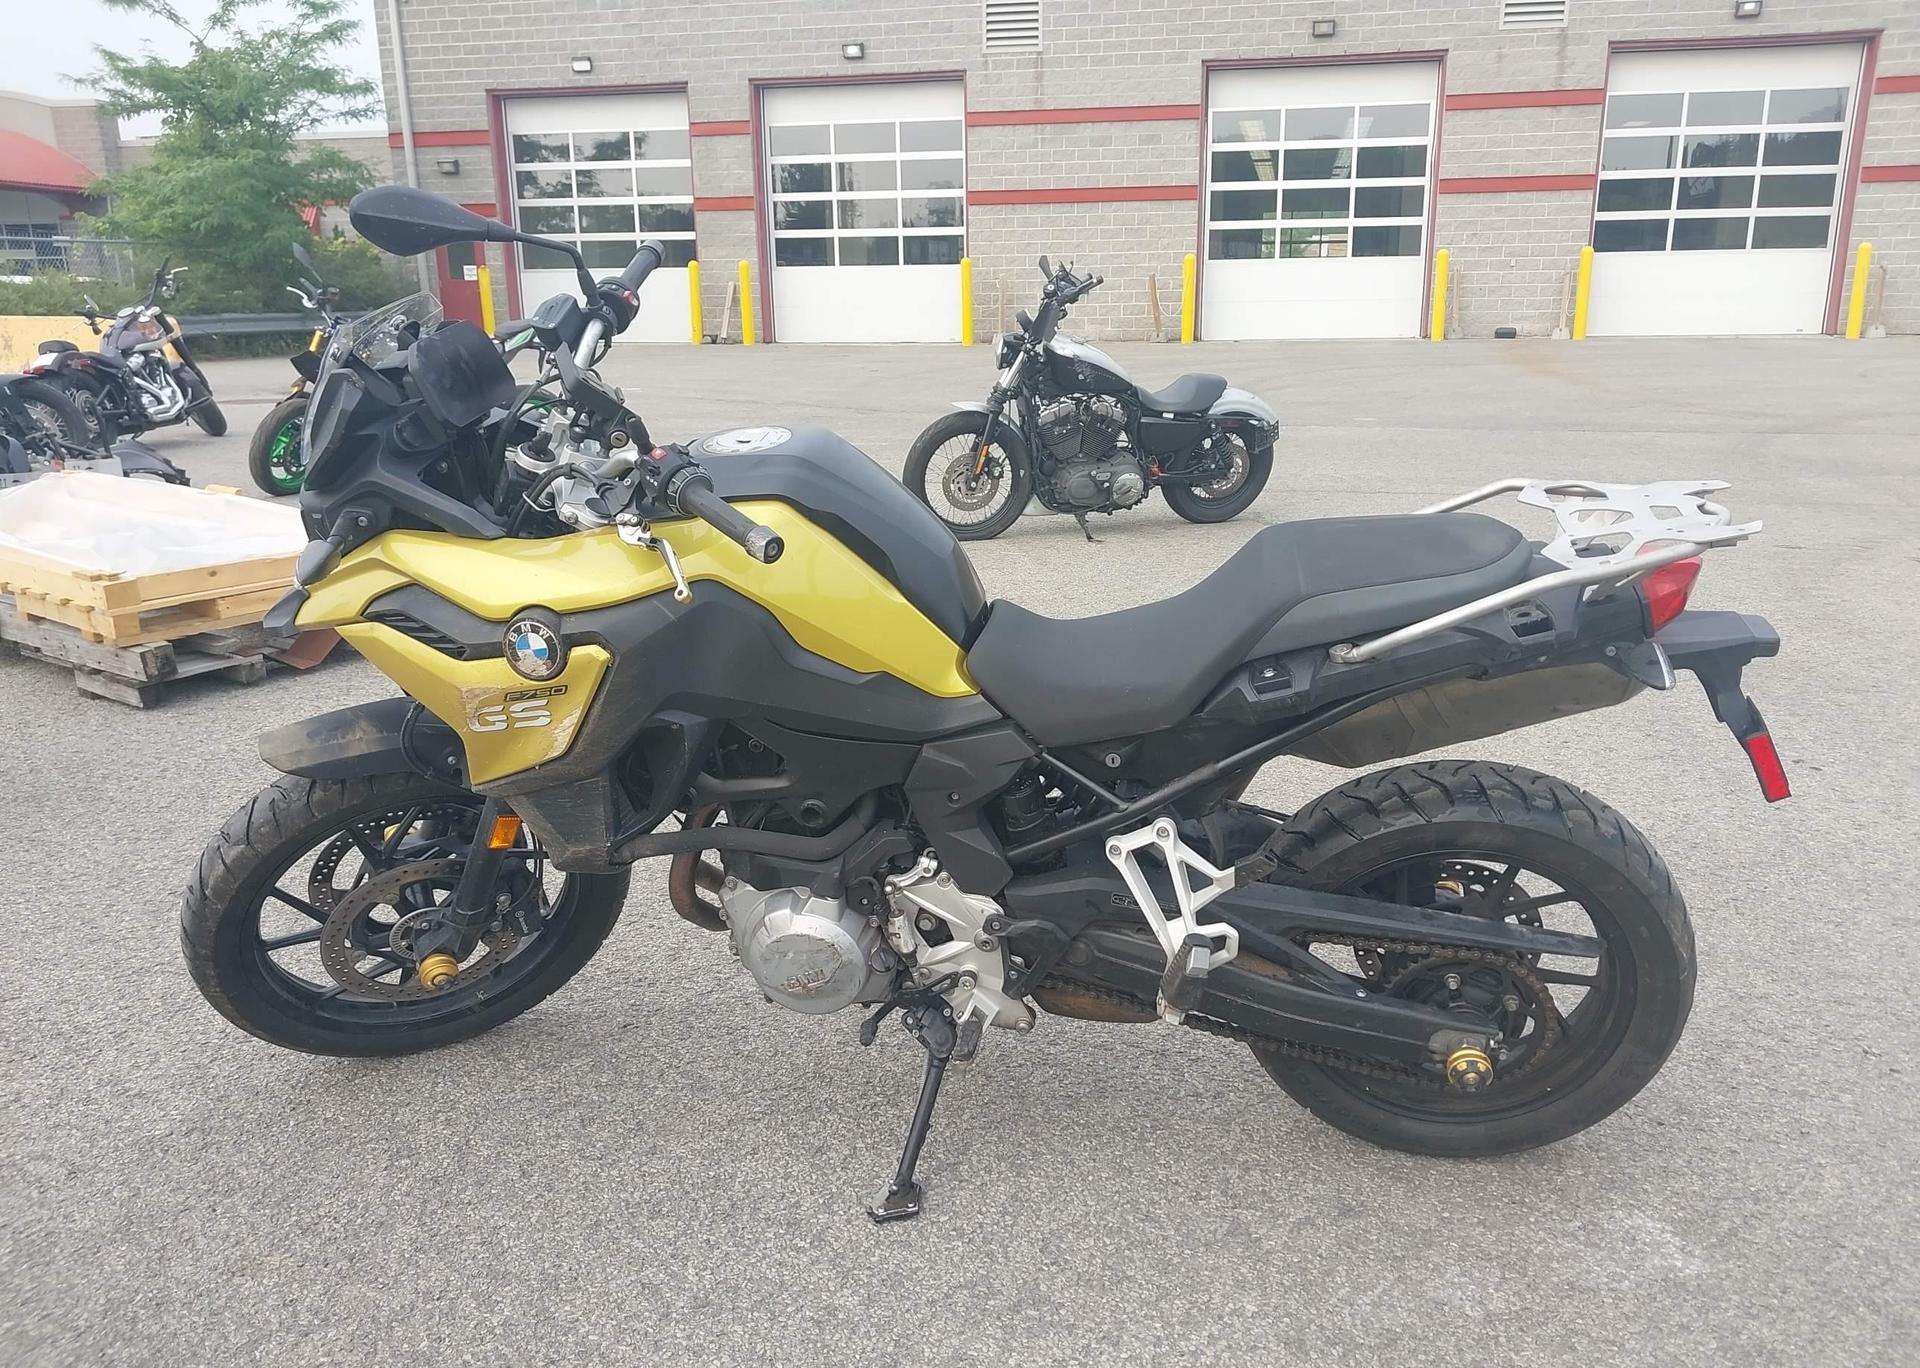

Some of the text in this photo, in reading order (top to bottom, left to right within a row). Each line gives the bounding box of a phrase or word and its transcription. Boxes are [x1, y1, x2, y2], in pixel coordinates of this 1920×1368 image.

[508, 623, 550, 642] BMW
[507, 686, 566, 701] F750
[468, 700, 551, 732] GS
